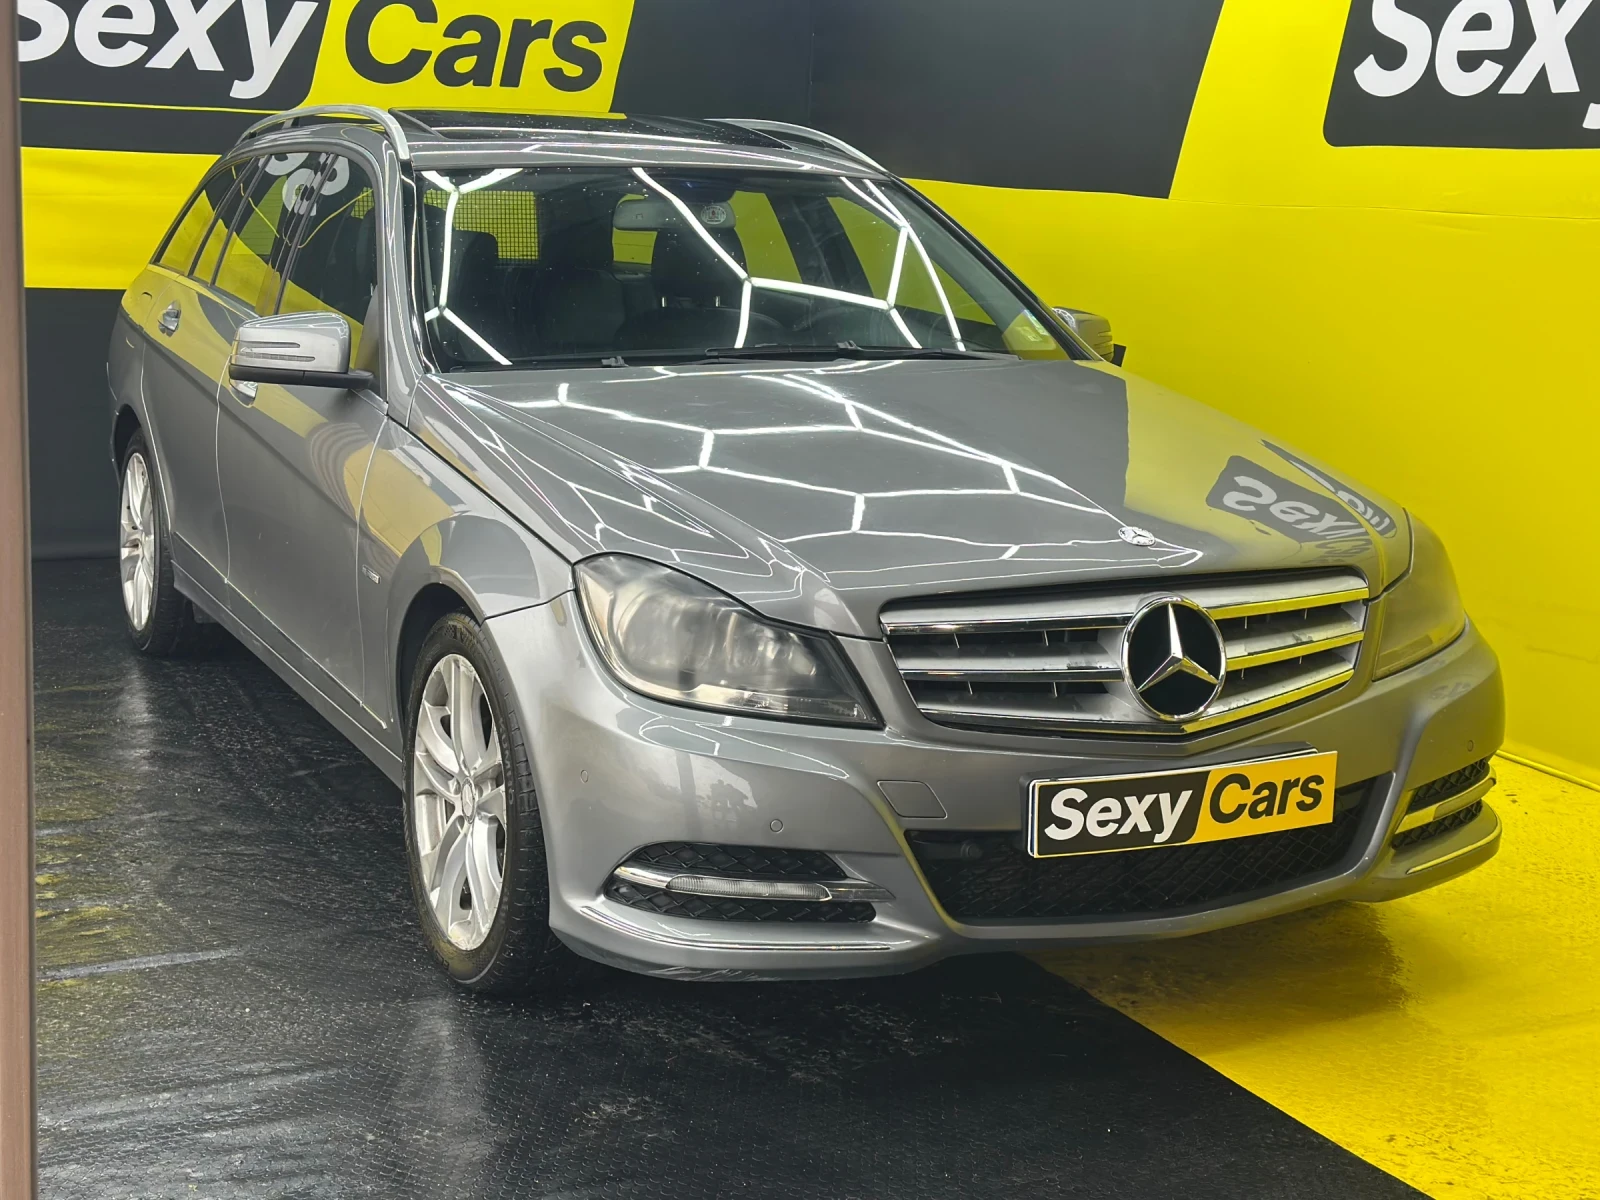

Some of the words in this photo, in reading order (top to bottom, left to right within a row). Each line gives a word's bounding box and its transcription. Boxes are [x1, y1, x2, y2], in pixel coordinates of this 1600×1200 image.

[345, 0, 607, 92] Cars
[1353, 0, 1600, 130] Sex
[1044, 787, 1193, 843] Sexy
[1208, 773, 1325, 825] Cars
